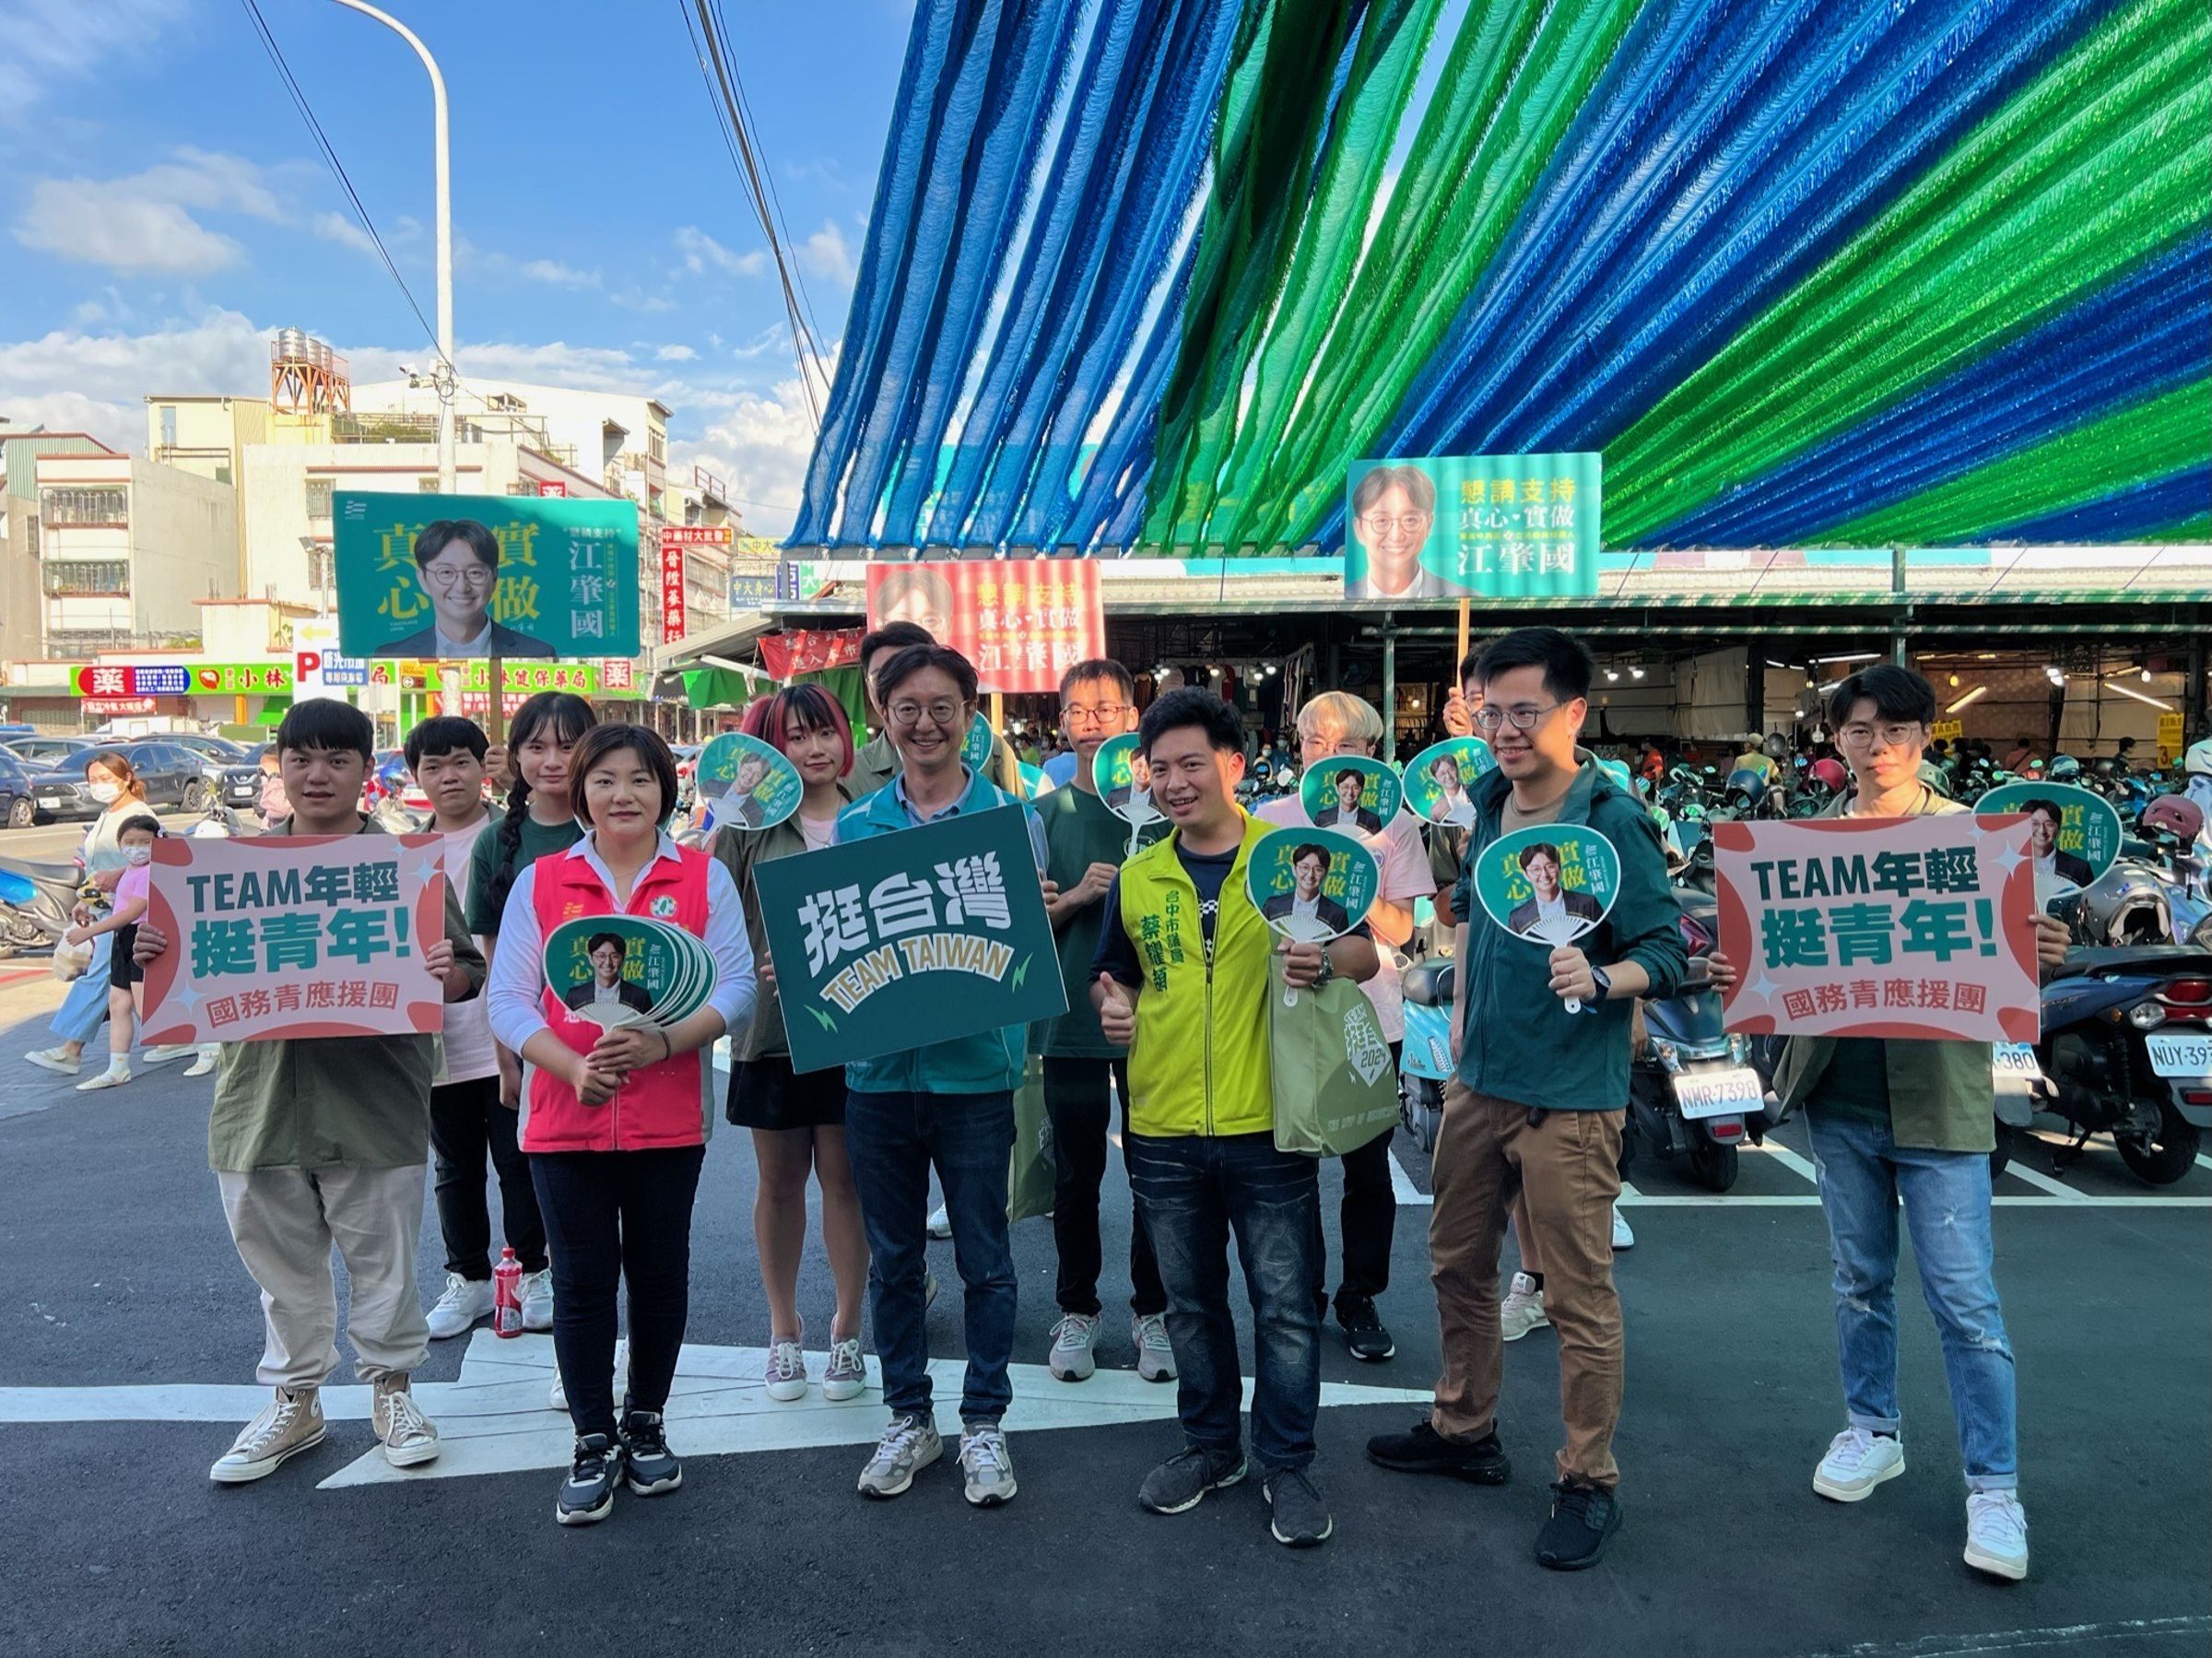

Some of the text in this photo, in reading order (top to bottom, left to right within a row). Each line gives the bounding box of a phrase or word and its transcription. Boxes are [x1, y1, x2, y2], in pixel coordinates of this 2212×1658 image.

[1458, 542, 1575, 576] 江肇國
[569, 541, 604, 639] 江肇國
[297, 653, 321, 682] P
[979, 641, 1087, 672] 江肇國
[186, 861, 400, 912] TEAM年輕
[1751, 846, 1980, 900] TEAM年輕
[797, 851, 1012, 978] 挺台灣
[1761, 899, 1997, 969] 挺青年!
[192, 906, 410, 979] 挺青年!
[819, 933, 1015, 1014] TEAM TAIWAN
[1783, 978, 1987, 1021] 國務青應援團
[206, 980, 399, 1029] 國務青應援團
